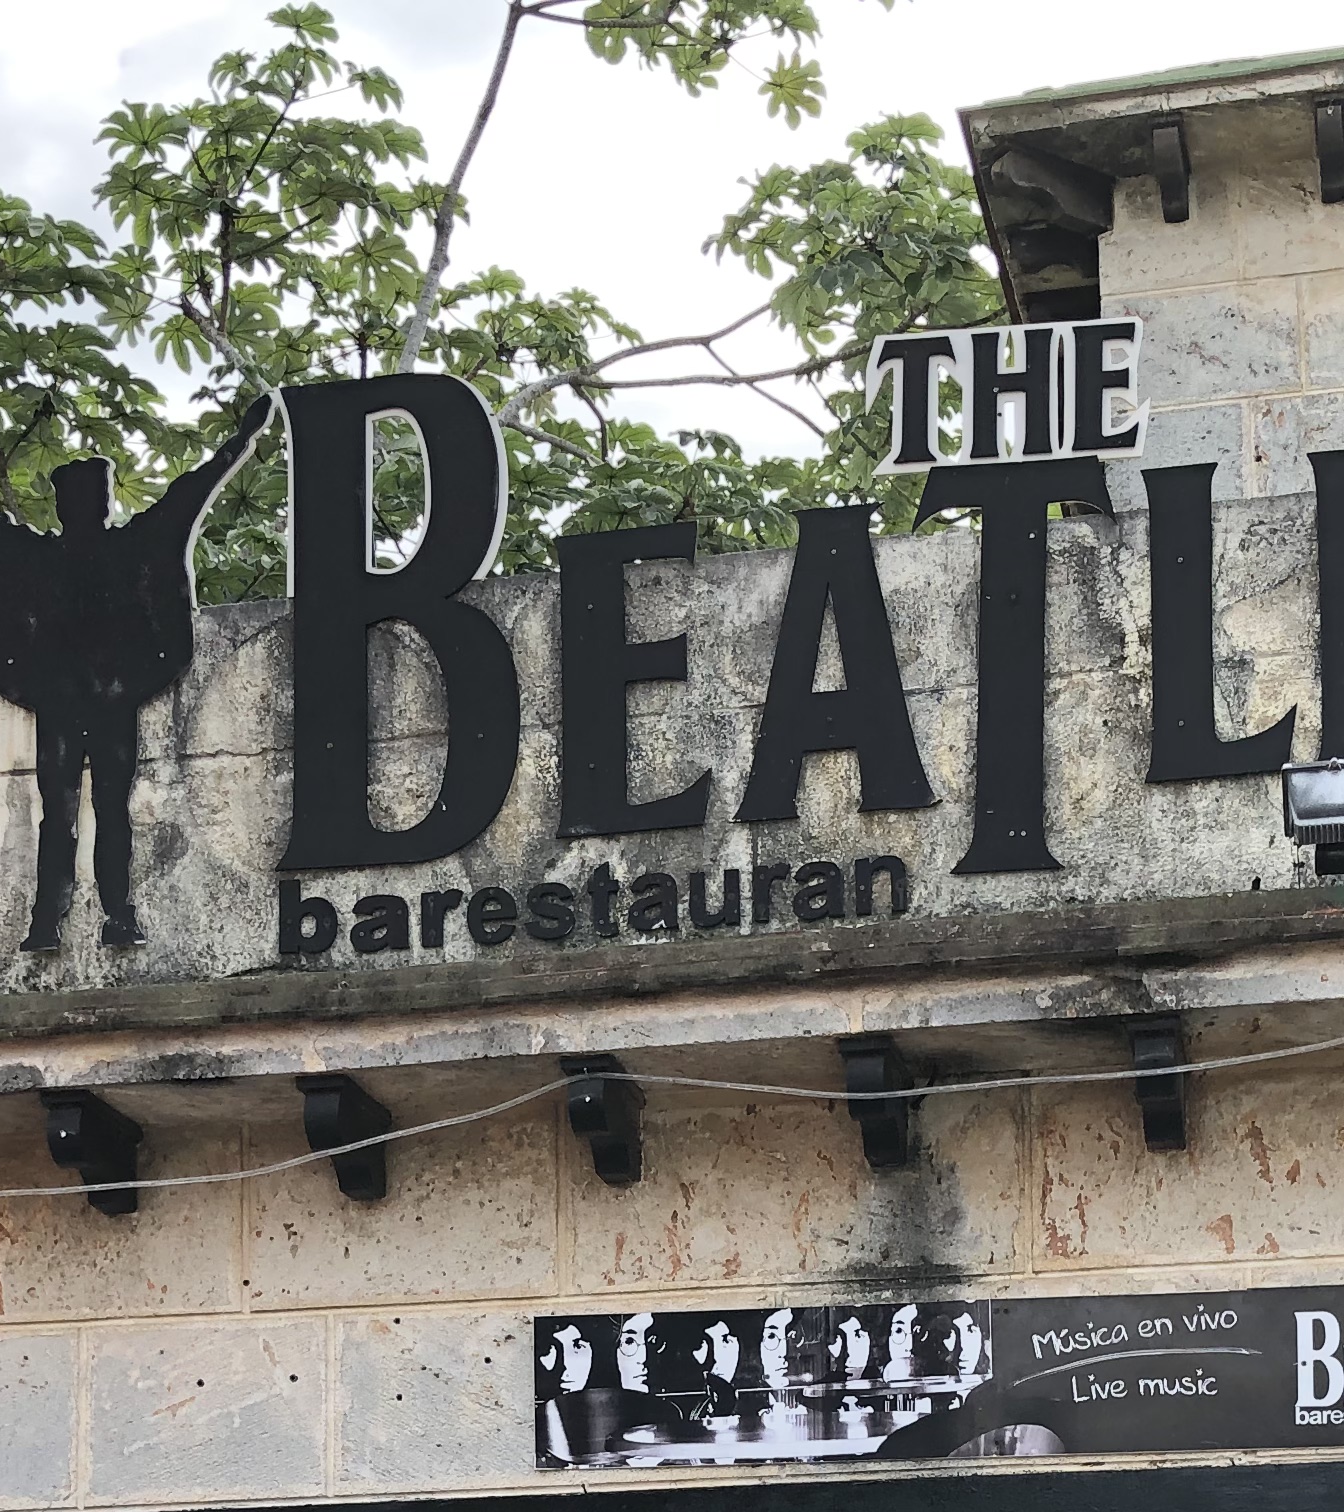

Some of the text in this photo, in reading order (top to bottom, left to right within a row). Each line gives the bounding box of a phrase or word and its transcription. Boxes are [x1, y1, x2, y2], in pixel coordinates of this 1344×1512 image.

[880, 319, 1142, 466] THE
[277, 854, 908, 955] barestauran
[1031, 1304, 1238, 1359] Música en vivo
[1071, 1368, 1218, 1403] Live music
